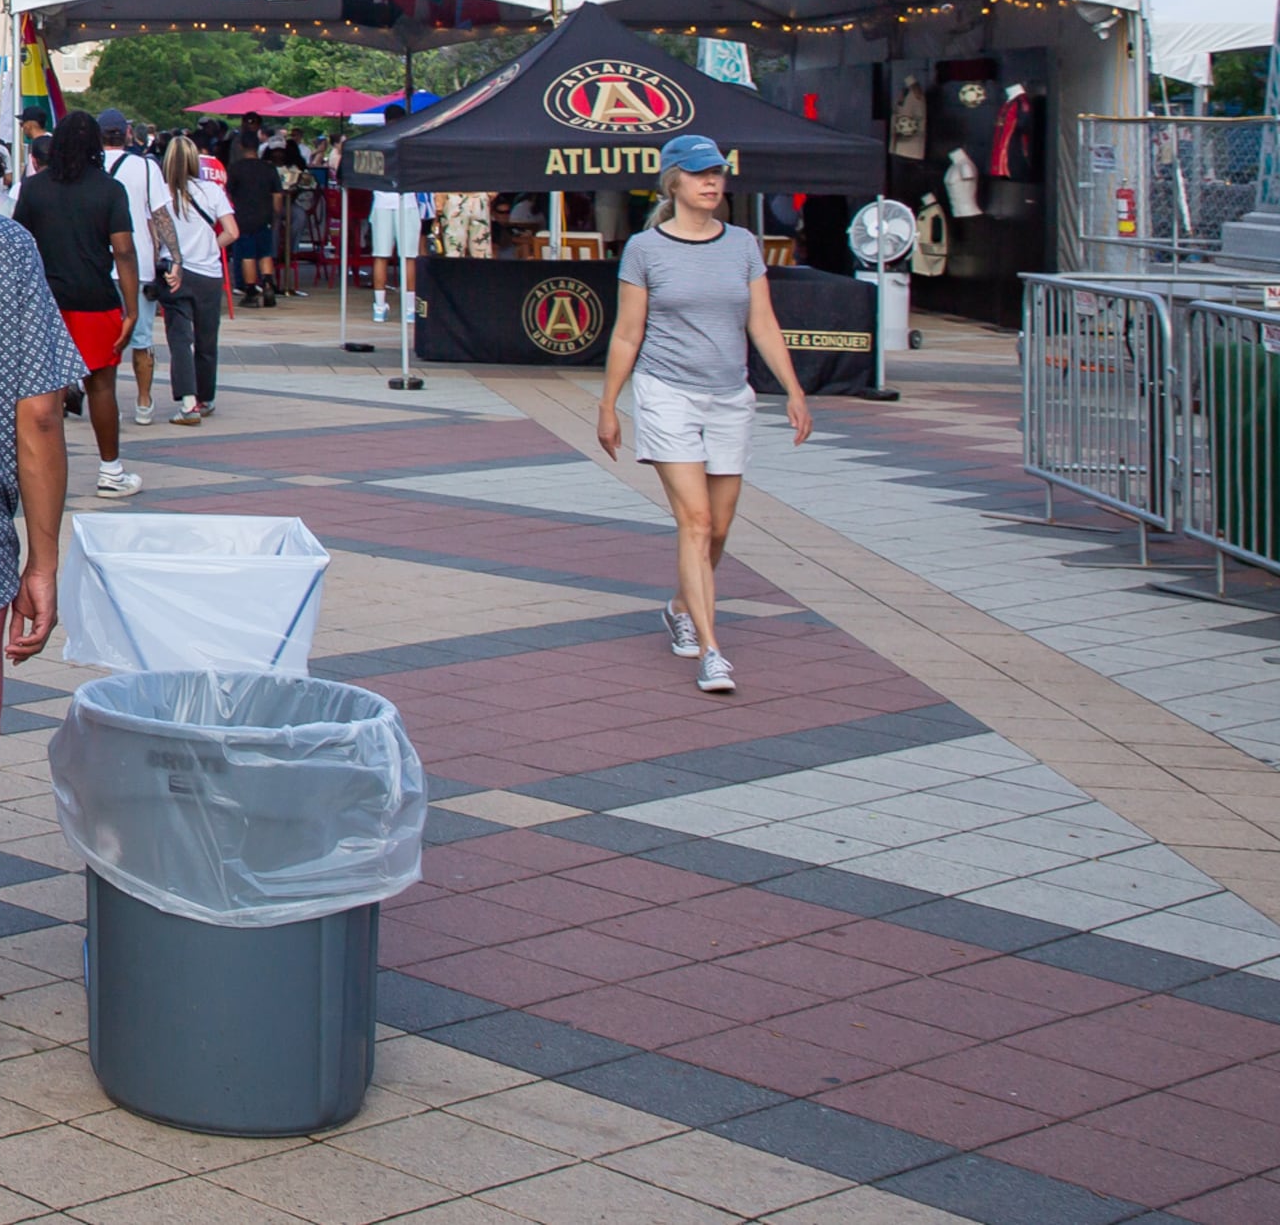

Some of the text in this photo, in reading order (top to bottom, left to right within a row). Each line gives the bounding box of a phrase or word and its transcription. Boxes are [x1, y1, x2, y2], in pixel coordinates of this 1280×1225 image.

[561, 63, 661, 88] ATLANTA
[568, 115, 683, 132] UNITED FC
[534, 280, 591, 299] ATLANTA
[532, 331, 593, 351] UNITED FC
[801, 334, 810, 345] &
[812, 334, 867, 347] CONQUER
